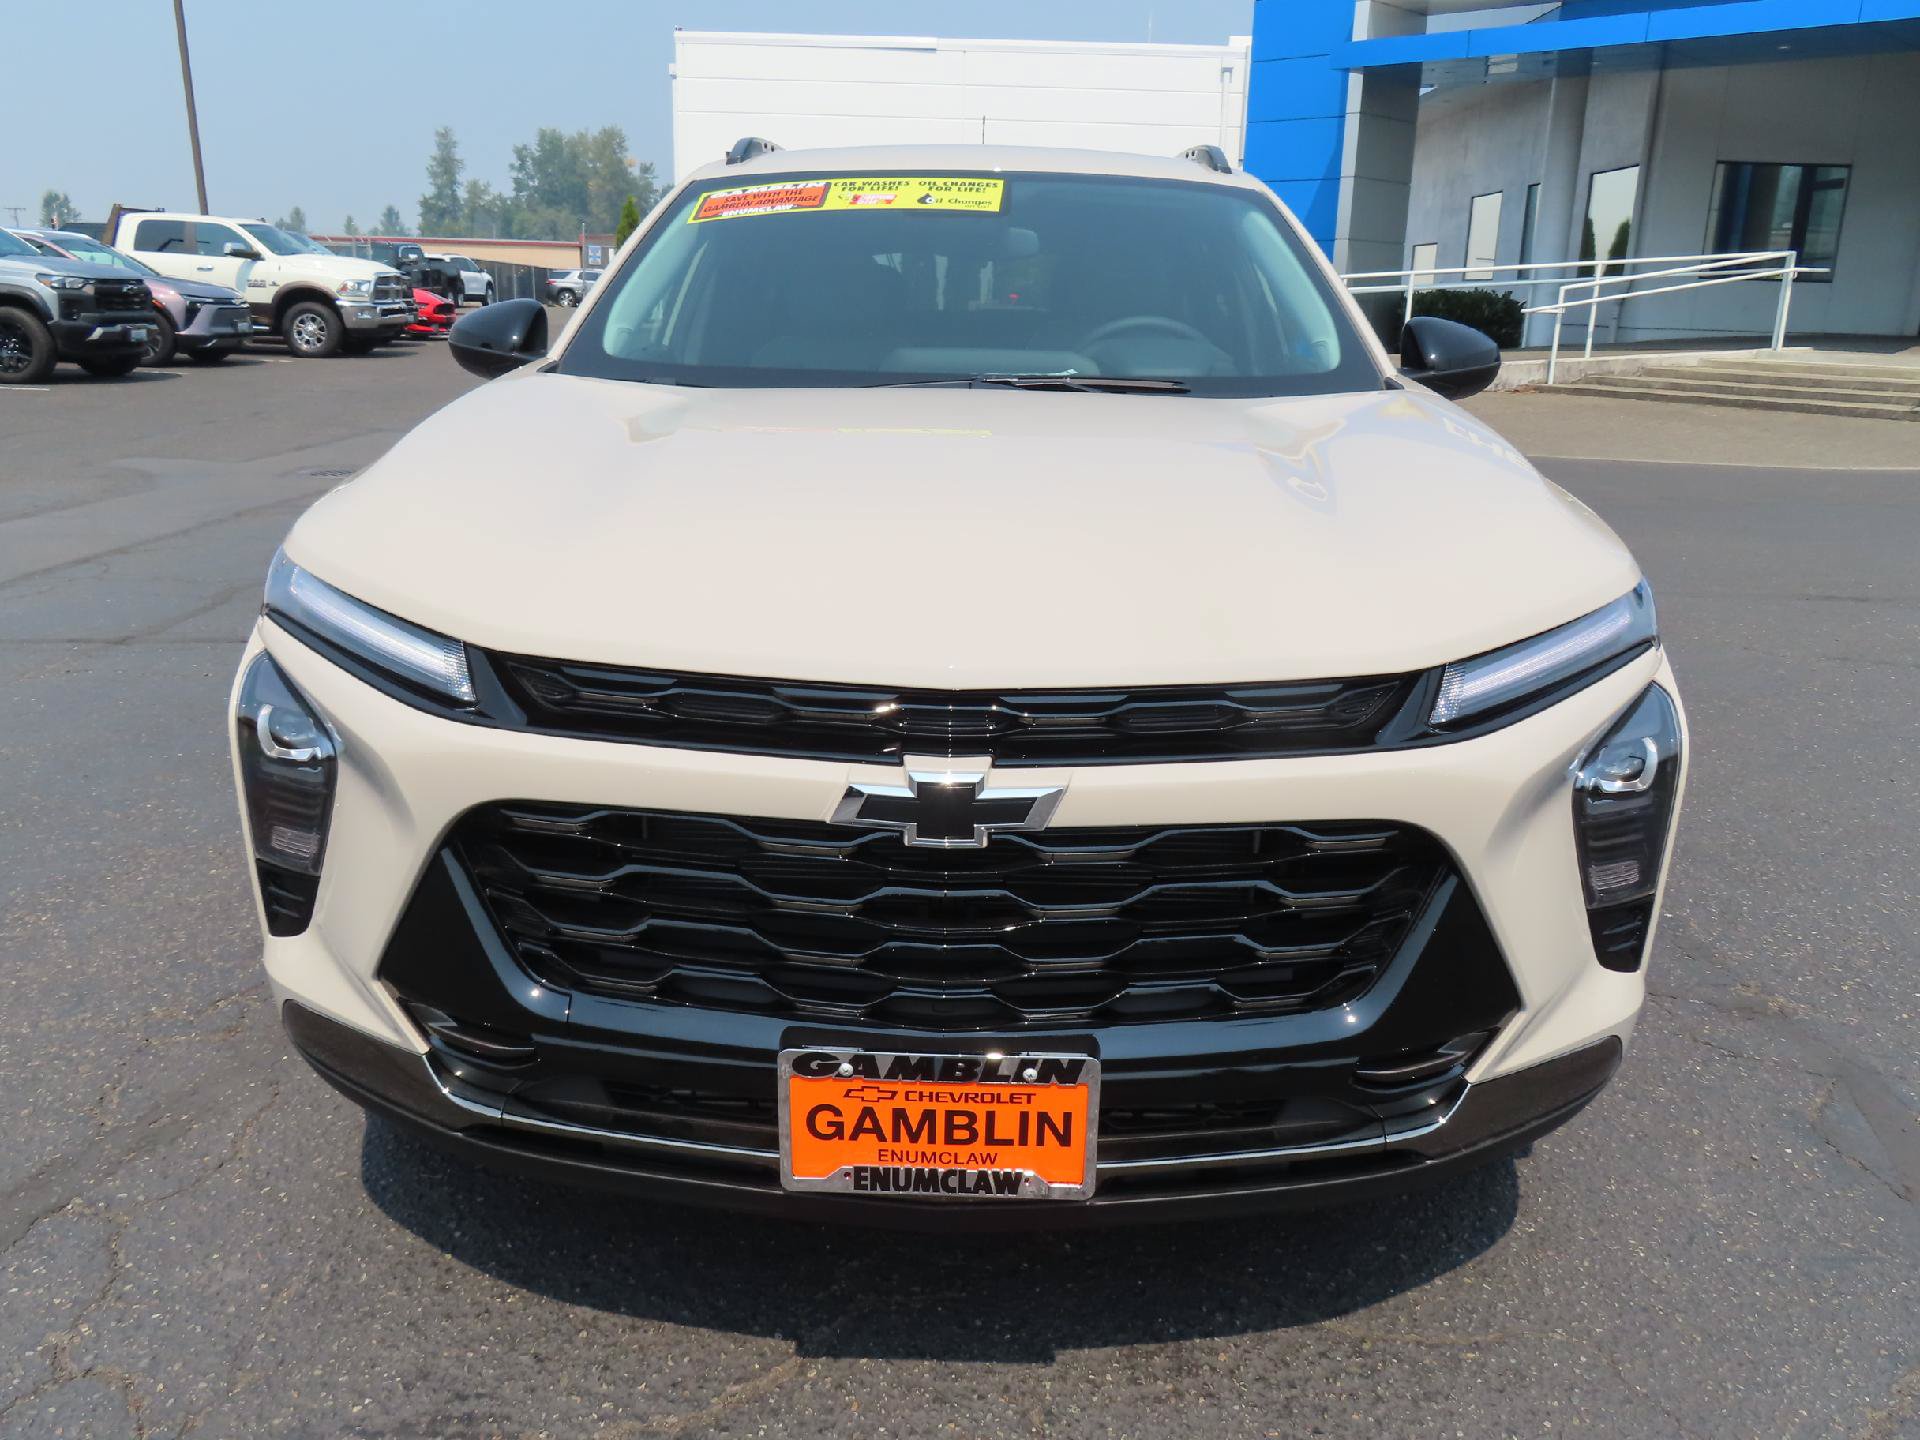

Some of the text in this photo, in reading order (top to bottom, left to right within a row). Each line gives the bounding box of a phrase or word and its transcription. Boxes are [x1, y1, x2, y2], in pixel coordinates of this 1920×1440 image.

[703, 195, 818, 212] GAMBLIN ADVANTAGE
[725, 194, 750, 203] SAVE
[753, 191, 781, 199] WITH
[948, 198, 993, 206] Changes
[792, 1052, 1086, 1085] GAMBLIN
[904, 1090, 1036, 1105] CHEVROLET
[805, 1103, 1073, 1148] GAMBLIN
[877, 1148, 998, 1166] ENUMCLAW
[853, 1166, 1023, 1195] ENUMCLAW
